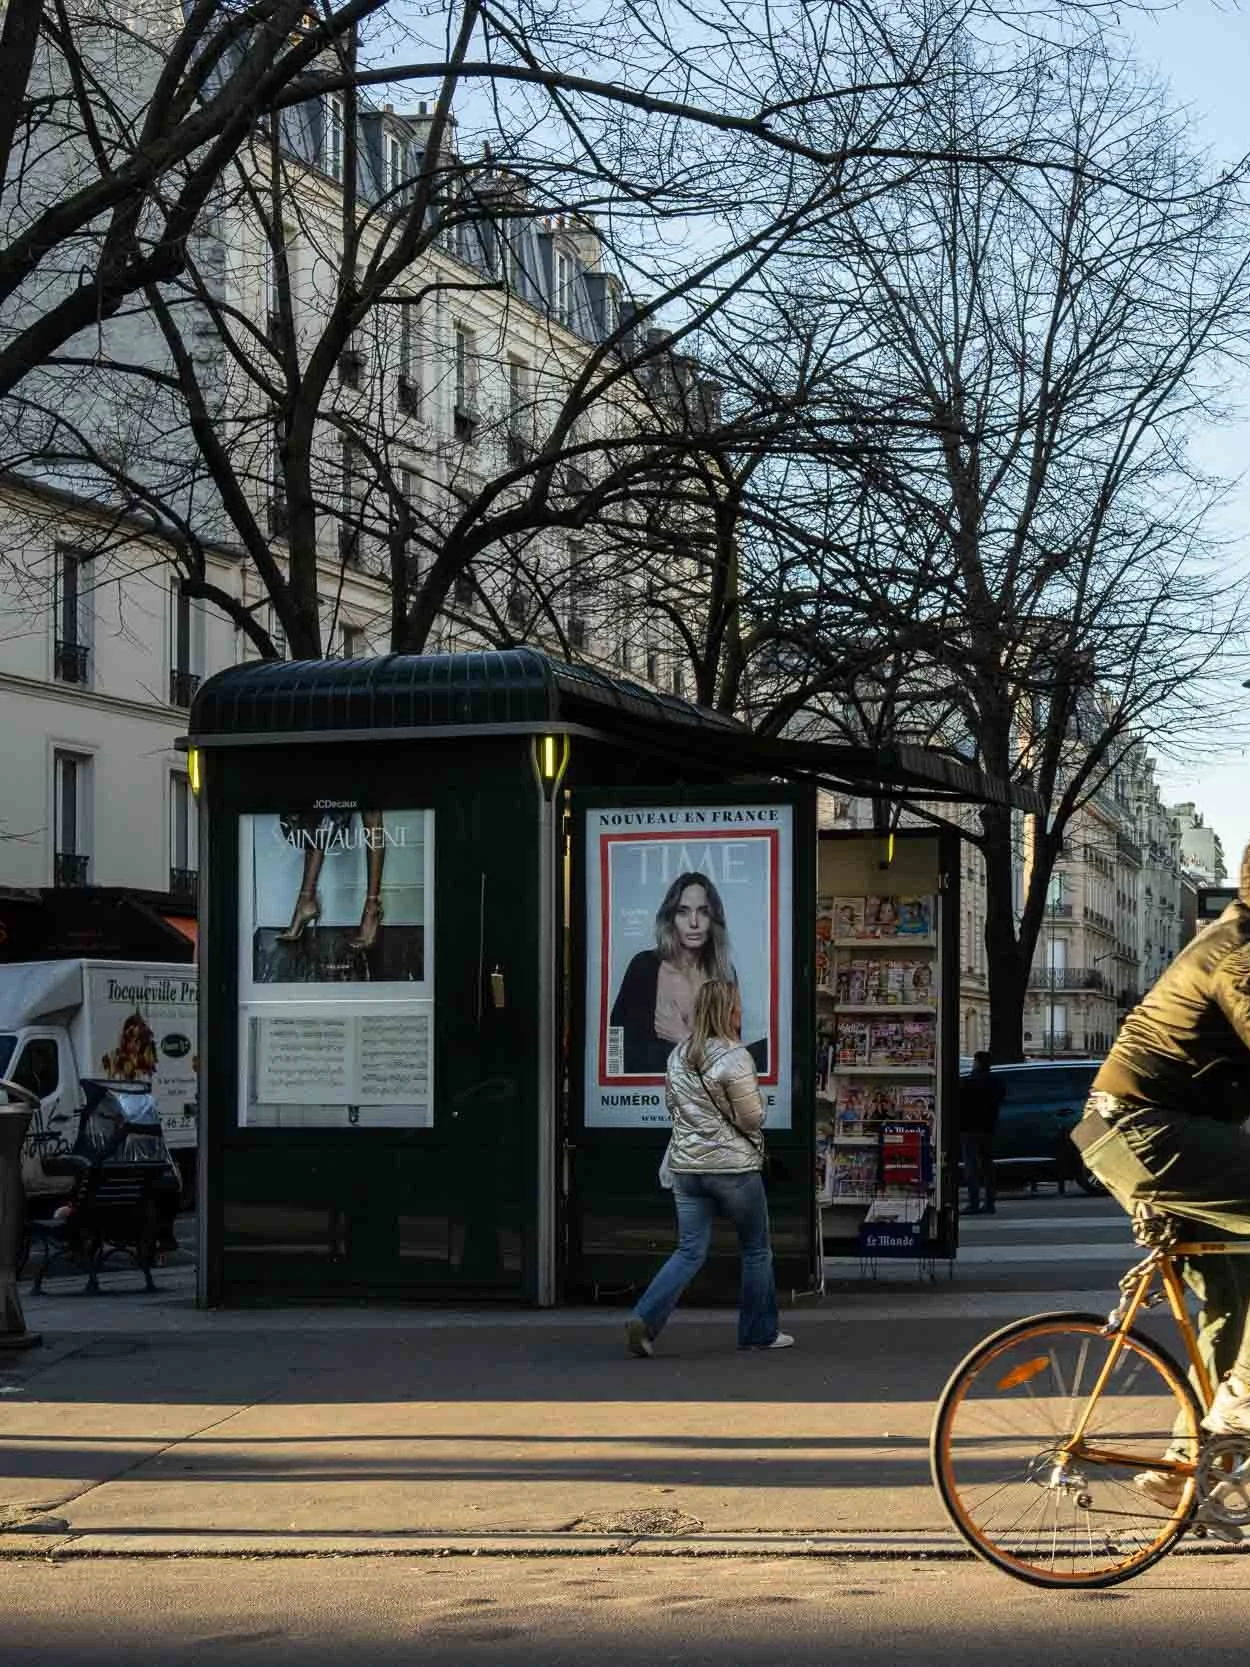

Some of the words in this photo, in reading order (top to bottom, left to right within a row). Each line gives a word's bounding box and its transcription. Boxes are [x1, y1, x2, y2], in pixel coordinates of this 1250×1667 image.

[313, 799, 357, 809] JCDecaux
[599, 811, 679, 826] NOUVEAU
[685, 810, 705, 823] EN
[712, 809, 779, 823] FRANCE
[631, 843, 749, 886] TIME
[107, 979, 176, 1004] Tocqueville
[600, 1093, 660, 1107] NUMÉRO
[866, 1236, 877, 1247] Le
[878, 1235, 914, 1247] Monde
